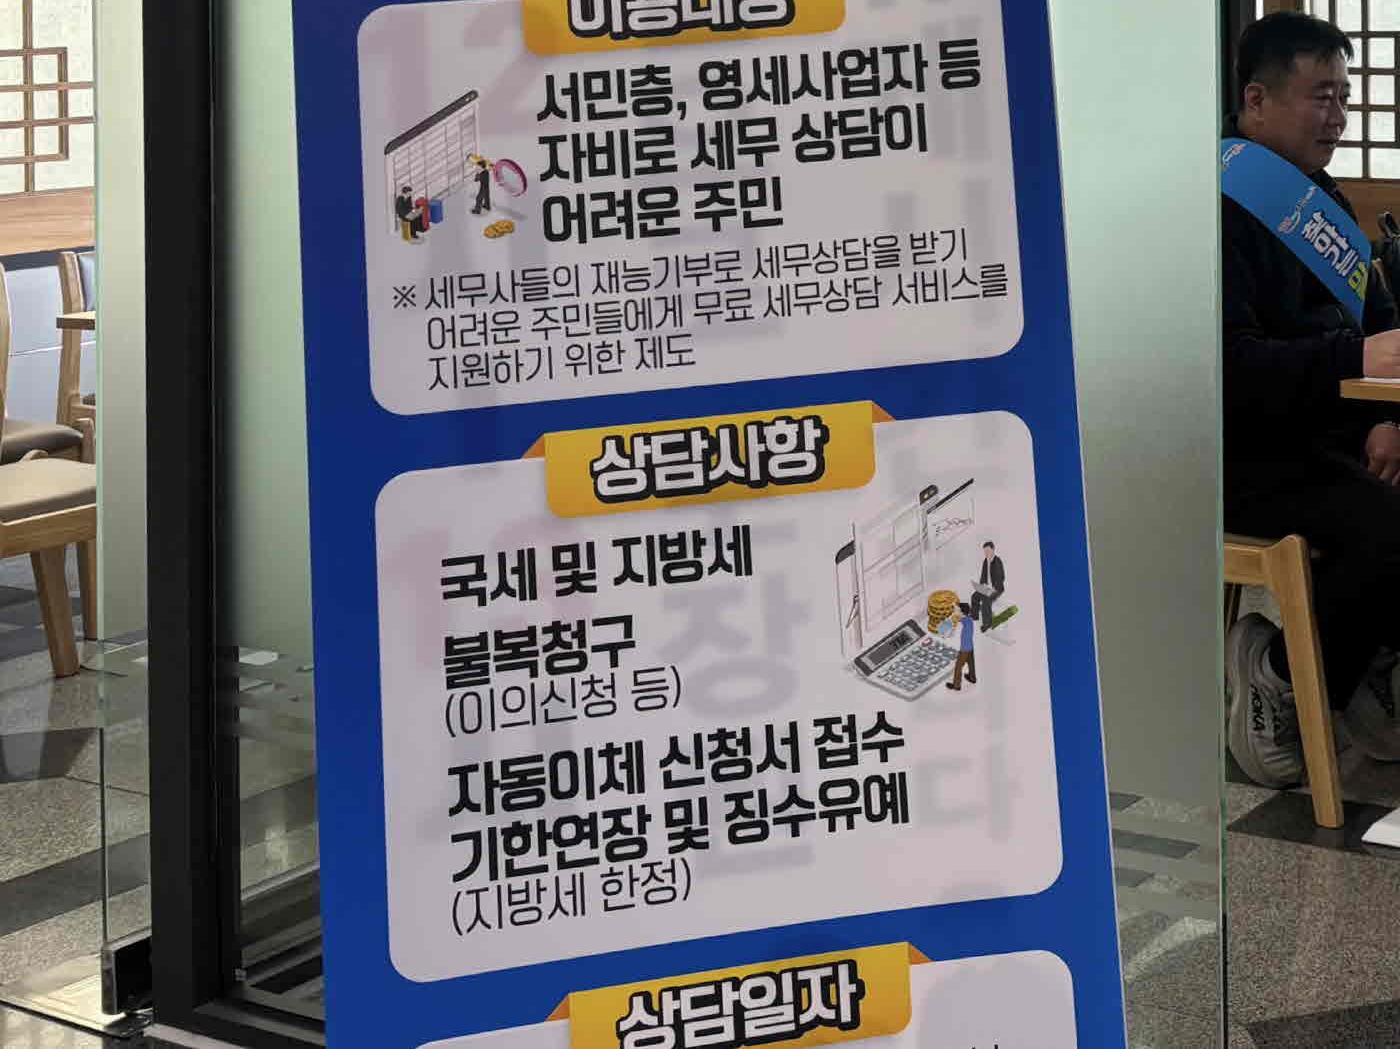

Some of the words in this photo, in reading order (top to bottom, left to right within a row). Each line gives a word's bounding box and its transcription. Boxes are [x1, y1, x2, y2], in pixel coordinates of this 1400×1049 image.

[537, 65, 687, 123] 서민층,
[700, 44, 928, 109] 영세사업자
[938, 38, 982, 90] 등
[540, 127, 678, 184] 자비로
[690, 118, 779, 171] 세무
[792, 103, 929, 163] 상담이
[541, 186, 681, 244] 어려운
[693, 176, 785, 230] 주민
[424, 265, 579, 313] 세무사들의
[590, 250, 744, 295] 재능기부로
[752, 235, 903, 282] 세무상담을
[909, 228, 968, 263] 받기
[427, 308, 522, 351] 어려운
[531, 294, 685, 341] 주민들에게
[692, 291, 754, 327] 무료
[763, 274, 883, 321] 세무상담
[891, 263, 1010, 304] 서비스를
[429, 345, 553, 391] 지원하기
[564, 339, 626, 378] 위한
[634, 334, 697, 371] 제도
[591, 420, 822, 498] 상담사항
[440, 548, 537, 607] 국세
[551, 541, 599, 596] 및
[612, 525, 754, 588] 지방세
[443, 614, 636, 690] 불복청구
[445, 673, 617, 738] (이의신청
[630, 665, 683, 715] 등)
[448, 738, 646, 817] 자동이체
[658, 720, 803, 787] 신청서
[812, 709, 906, 768] 접수
[451, 805, 651, 884] 기한연장
[665, 795, 710, 853] 및
[723, 771, 910, 843] 징수유예
[451, 870, 586, 937] (지방세
[601, 856, 692, 912] 한정)
[617, 963, 860, 1049] 상담일자
